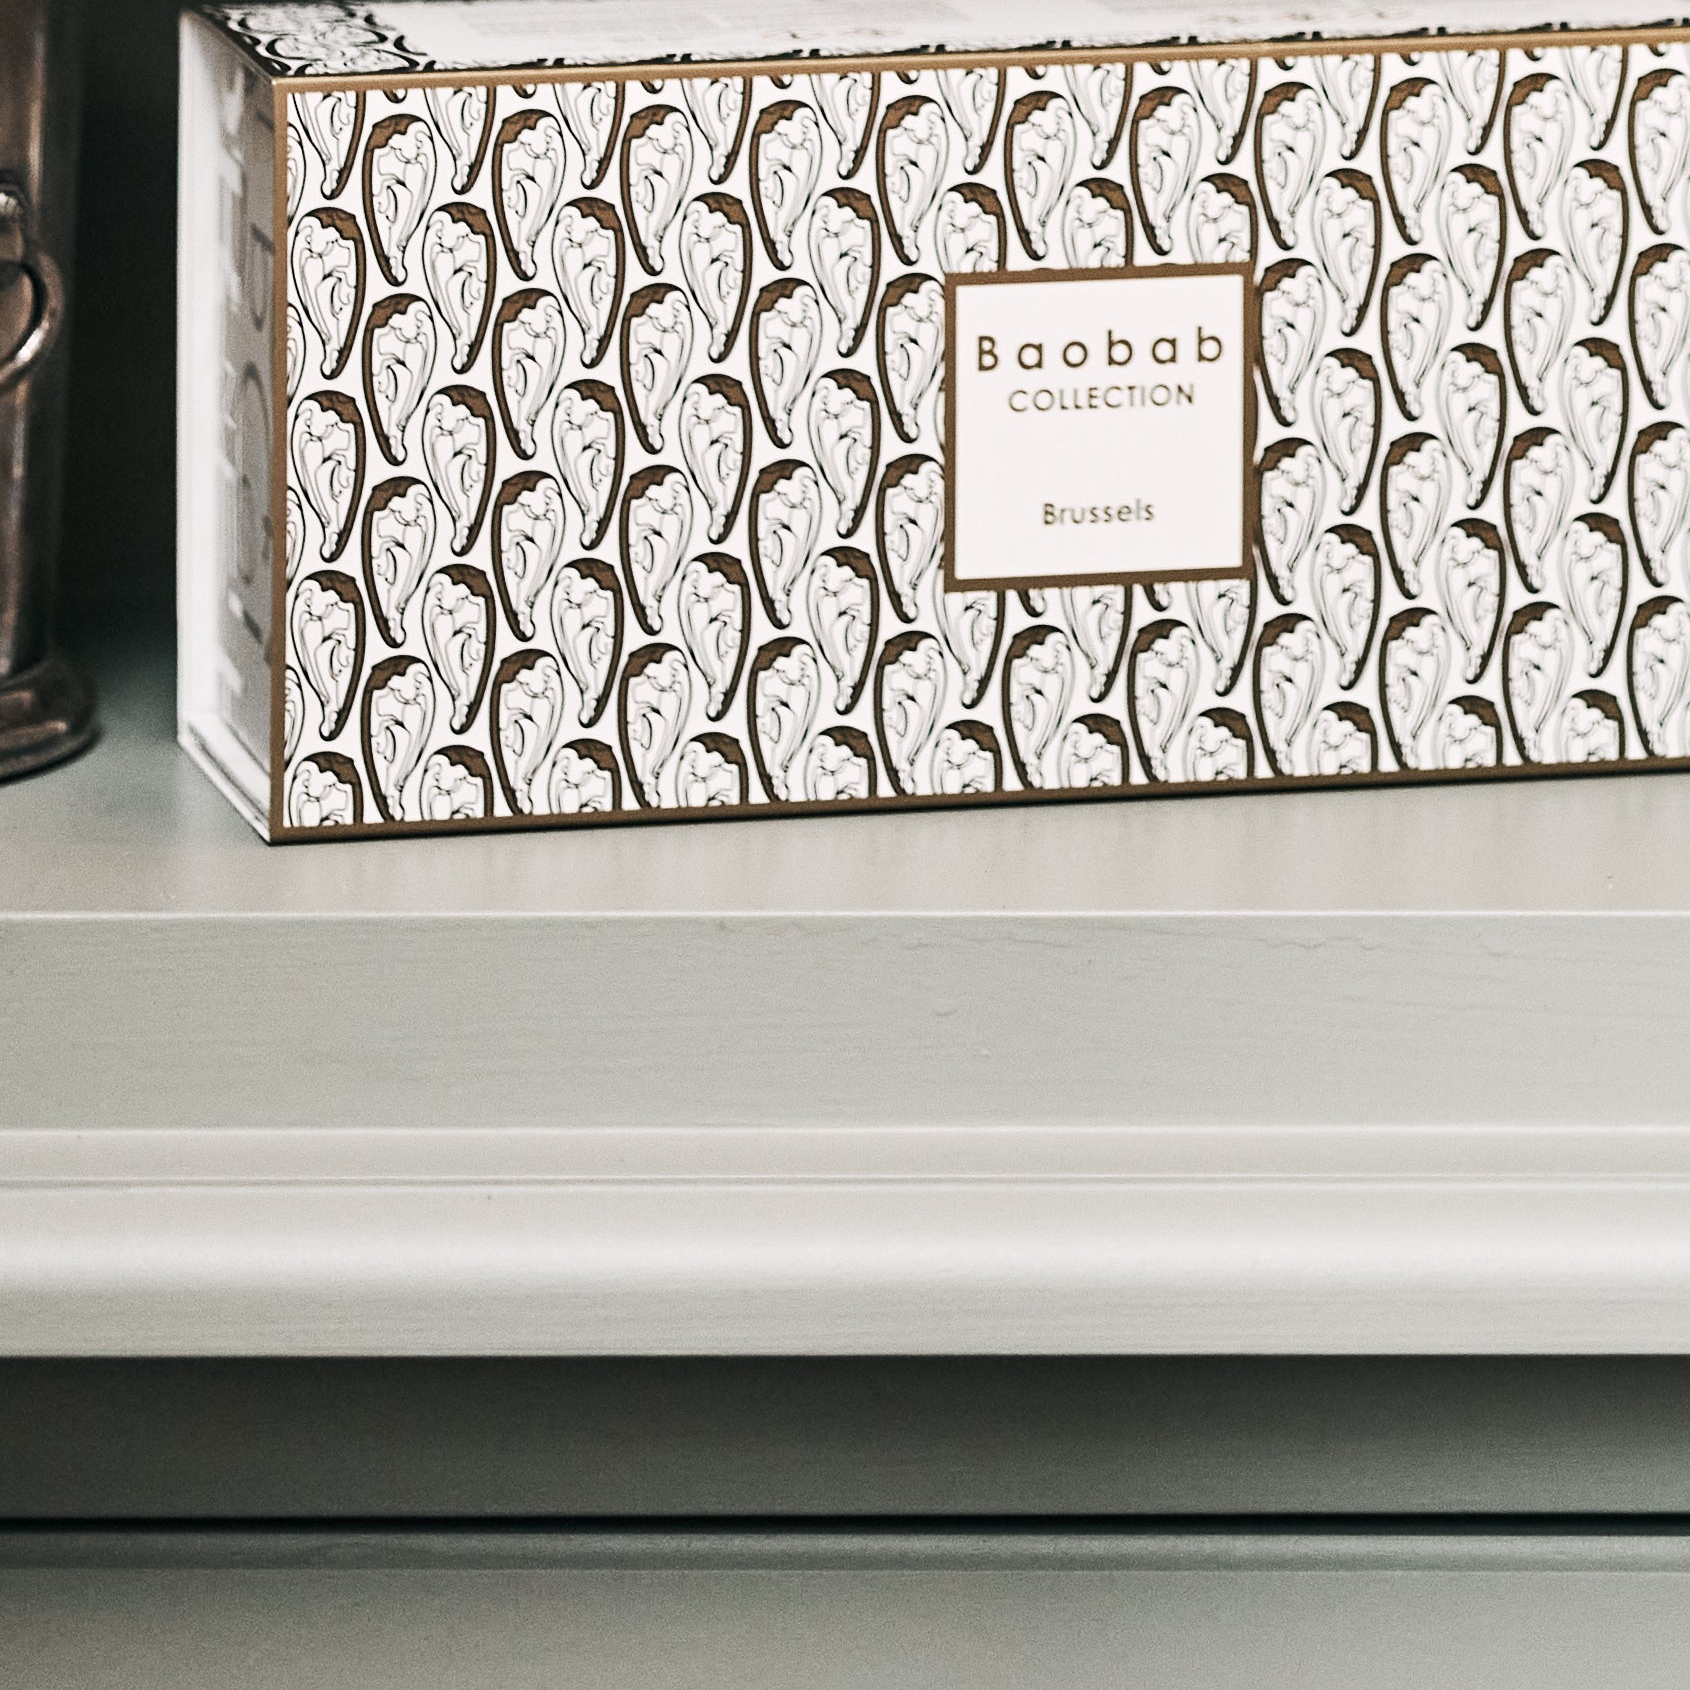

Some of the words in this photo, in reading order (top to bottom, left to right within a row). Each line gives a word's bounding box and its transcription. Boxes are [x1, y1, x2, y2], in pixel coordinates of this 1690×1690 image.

[978, 326, 1223, 371] Baobab
[1008, 383, 1195, 412] COLLECTION
[1043, 498, 1156, 525] Brussels
